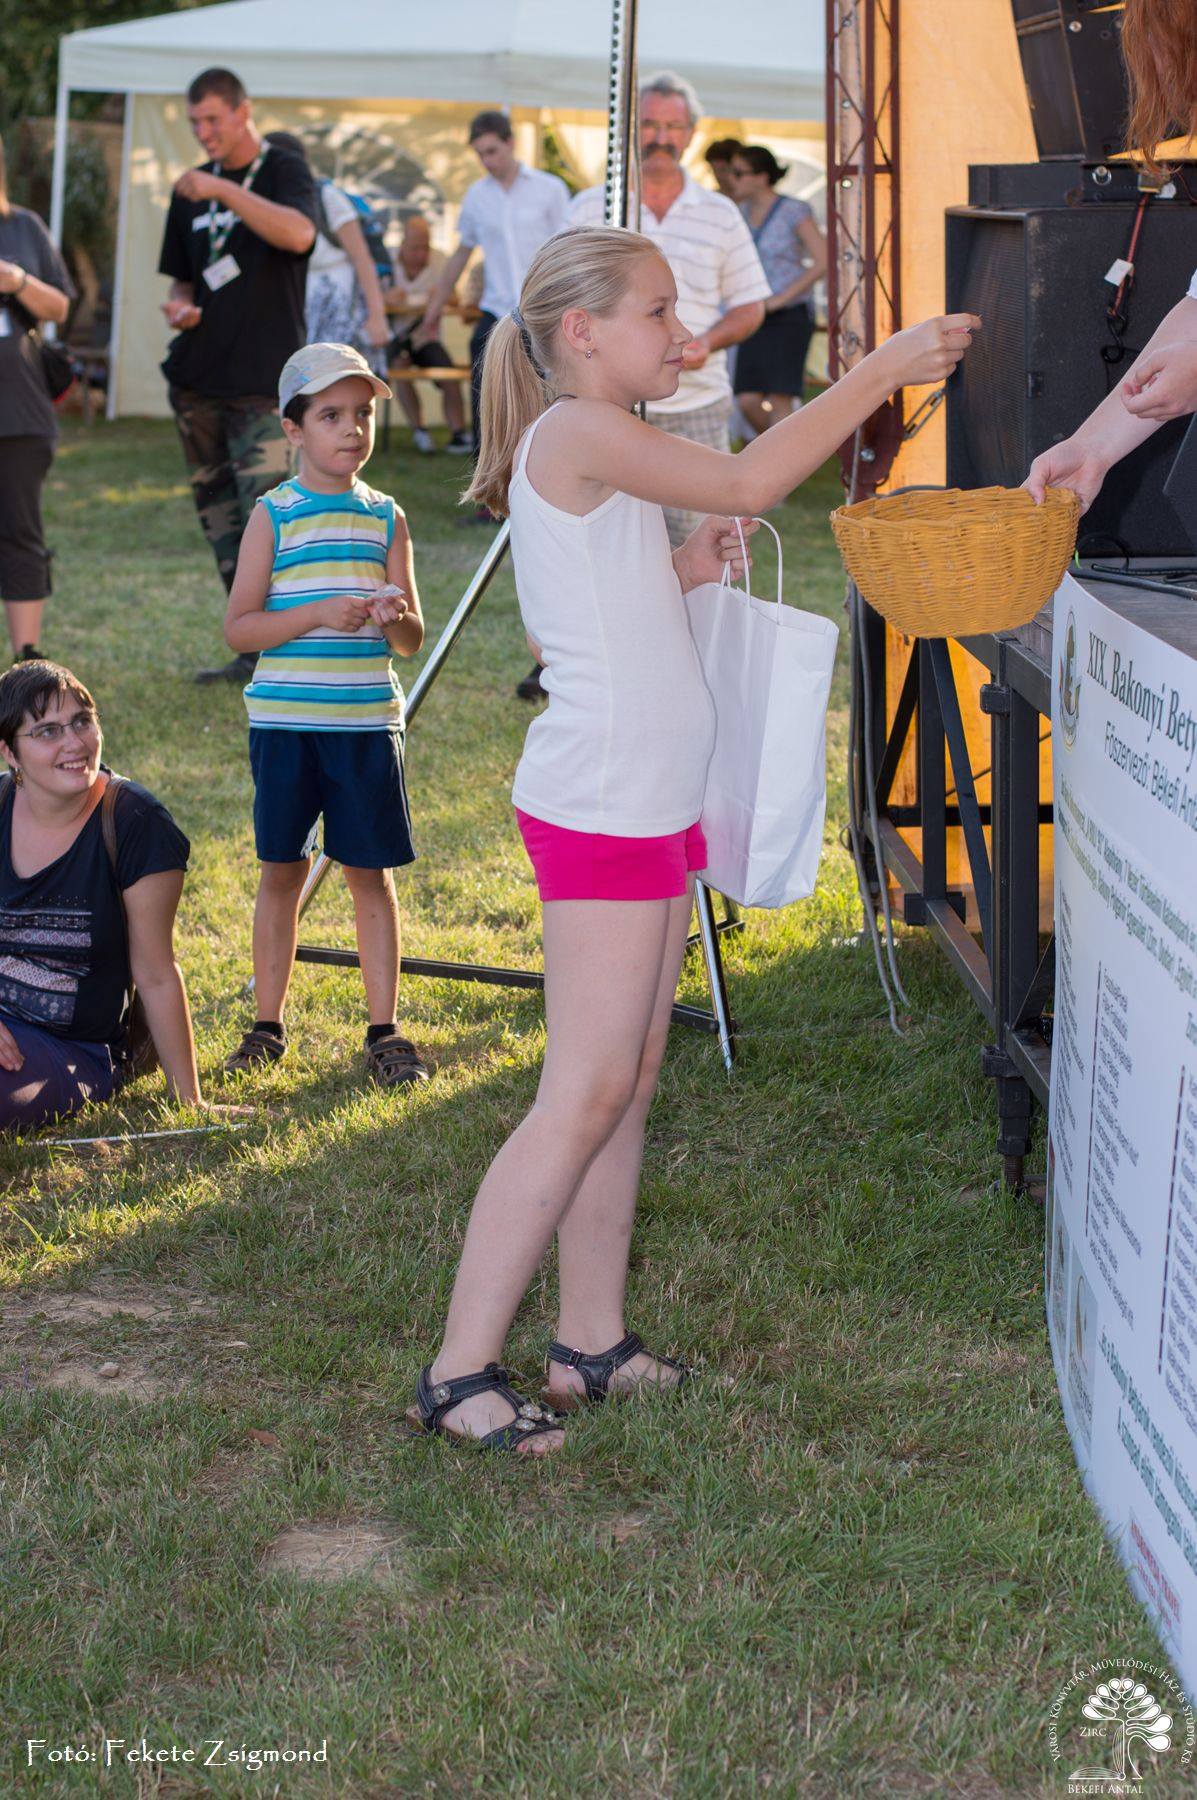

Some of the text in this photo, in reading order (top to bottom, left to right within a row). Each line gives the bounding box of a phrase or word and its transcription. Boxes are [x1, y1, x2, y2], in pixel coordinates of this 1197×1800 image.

[1087, 630, 1197, 773] XIX. Bakonyi Bety
[1104, 720, 1150, 791] Főszervező:
[1151, 759, 1180, 815] Békefi
